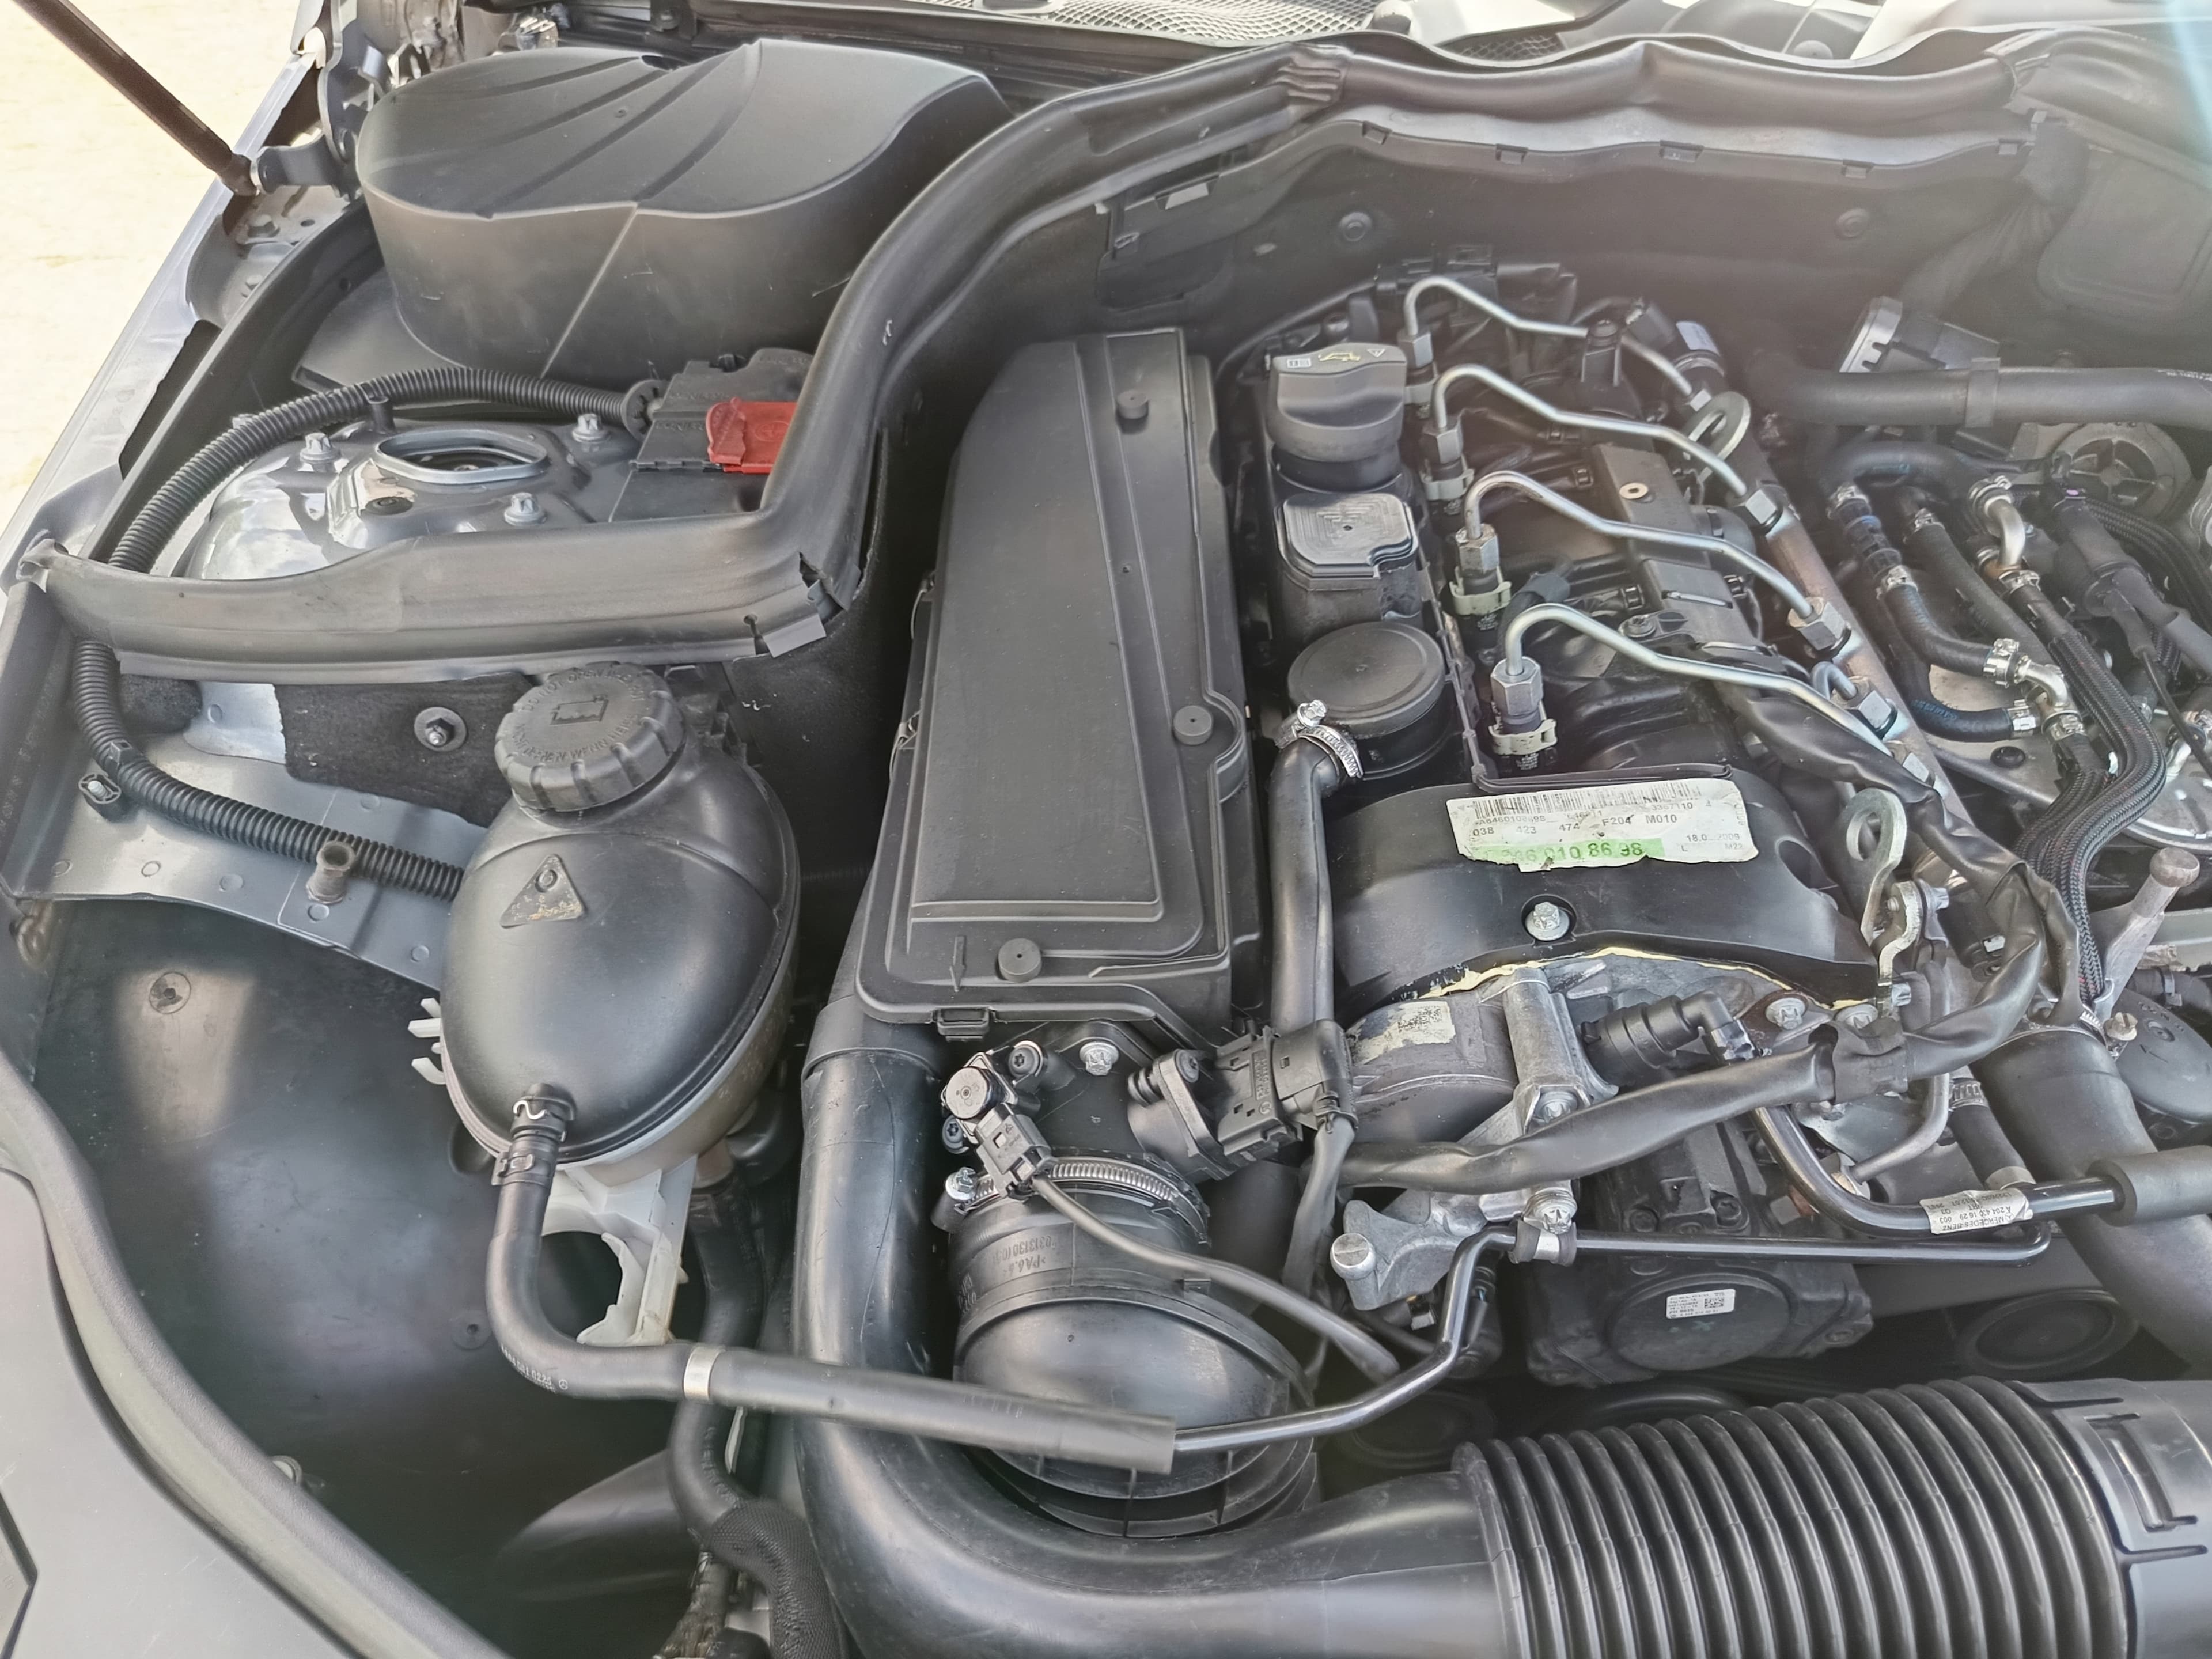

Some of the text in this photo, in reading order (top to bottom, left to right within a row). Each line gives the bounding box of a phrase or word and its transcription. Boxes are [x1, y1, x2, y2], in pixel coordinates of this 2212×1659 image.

[1472, 814, 1677, 836] 038 423 474 F204 M010
[1544, 846, 1581, 861] 010
[1587, 842, 1612, 857] 86
[1992, 1207, 2004, 1215] 204
[1940, 1216, 1952, 1224] 003
[1959, 1213, 1968, 1221] 29
